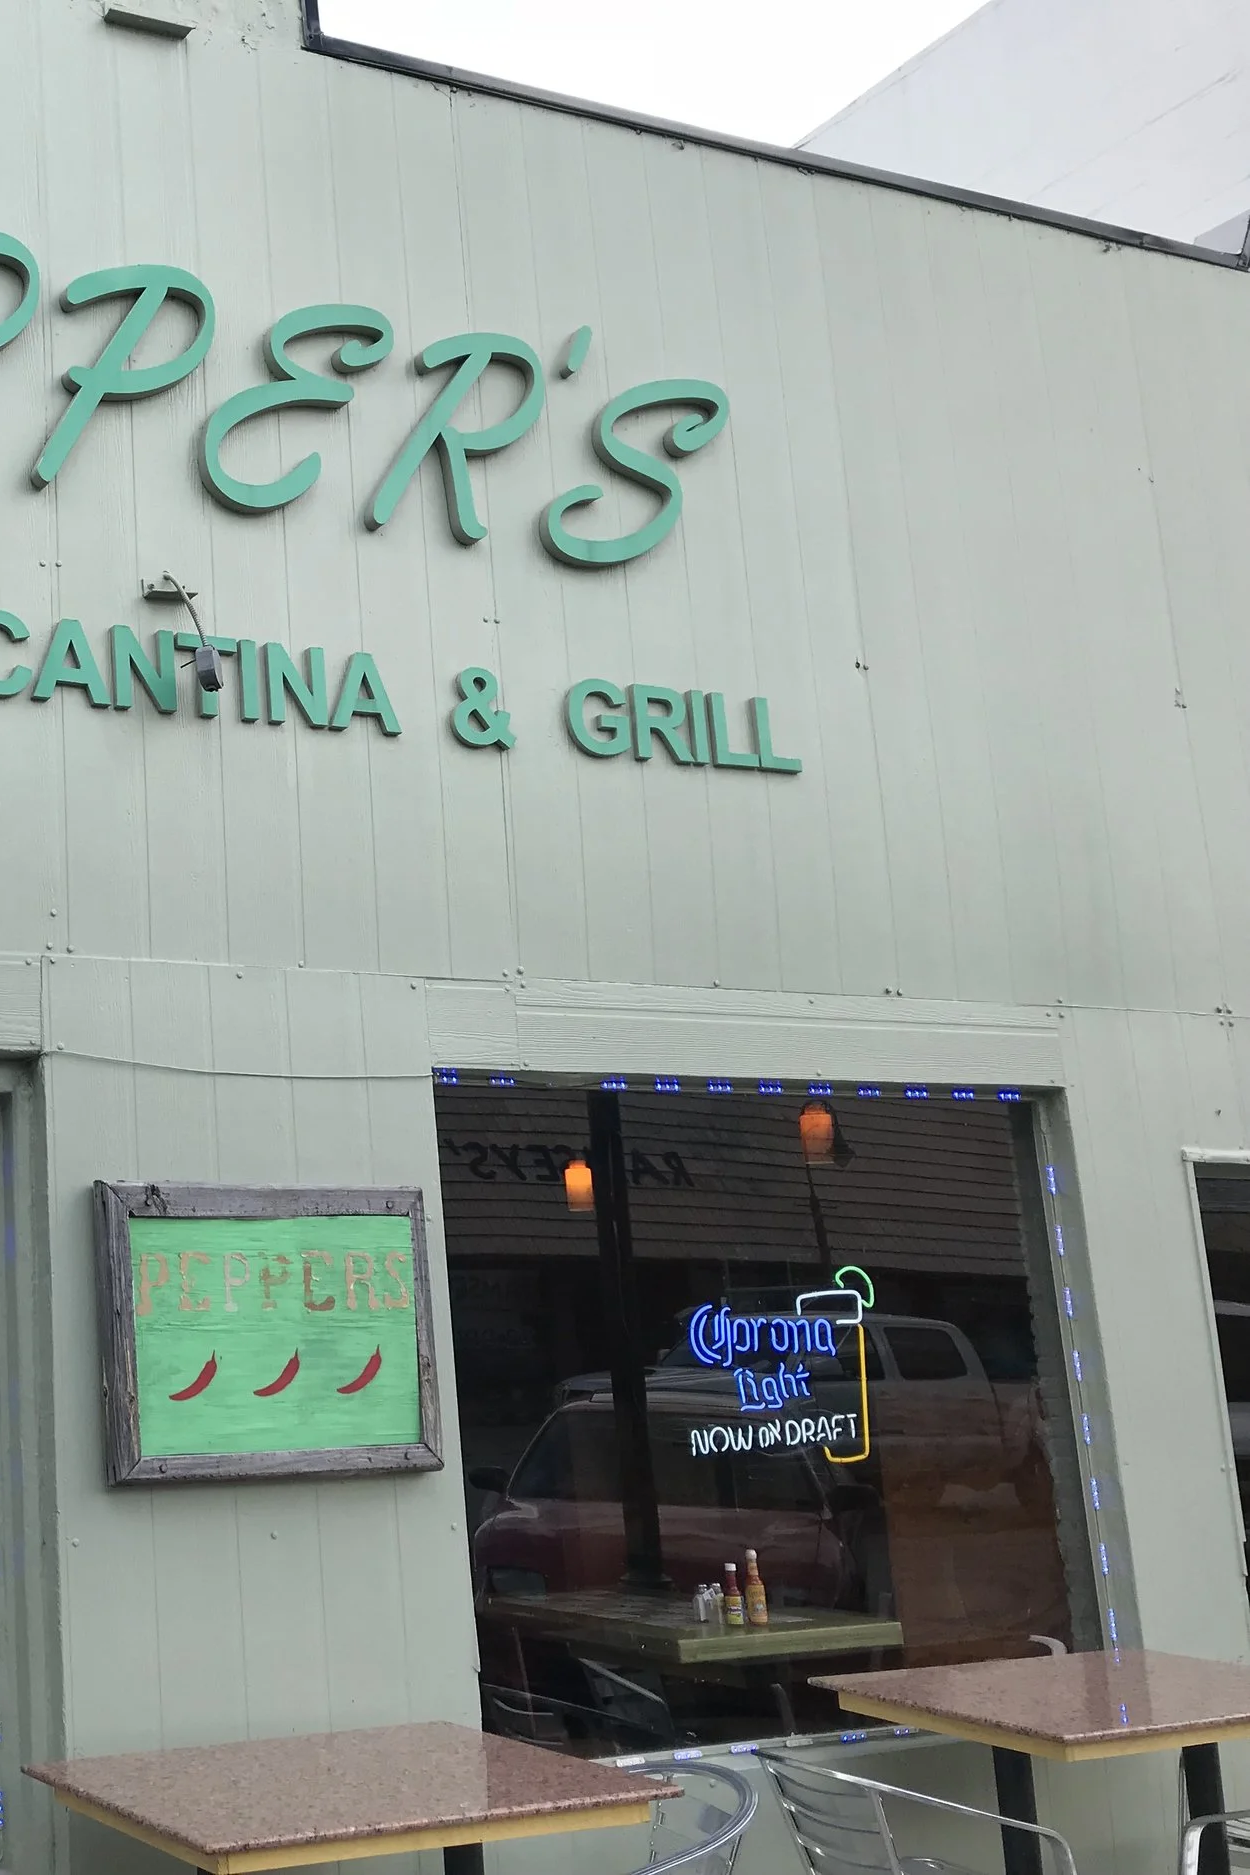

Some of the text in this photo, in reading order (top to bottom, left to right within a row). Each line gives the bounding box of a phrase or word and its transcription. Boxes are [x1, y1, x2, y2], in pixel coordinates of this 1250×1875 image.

[451, 666, 517, 750] &
[566, 678, 802, 774] GRILL
[136, 1250, 410, 1317] PEPPERS
[690, 1303, 837, 1367] Corona
[733, 1362, 811, 1412] Light
[690, 1413, 858, 1457] NOW ON DRAFT
